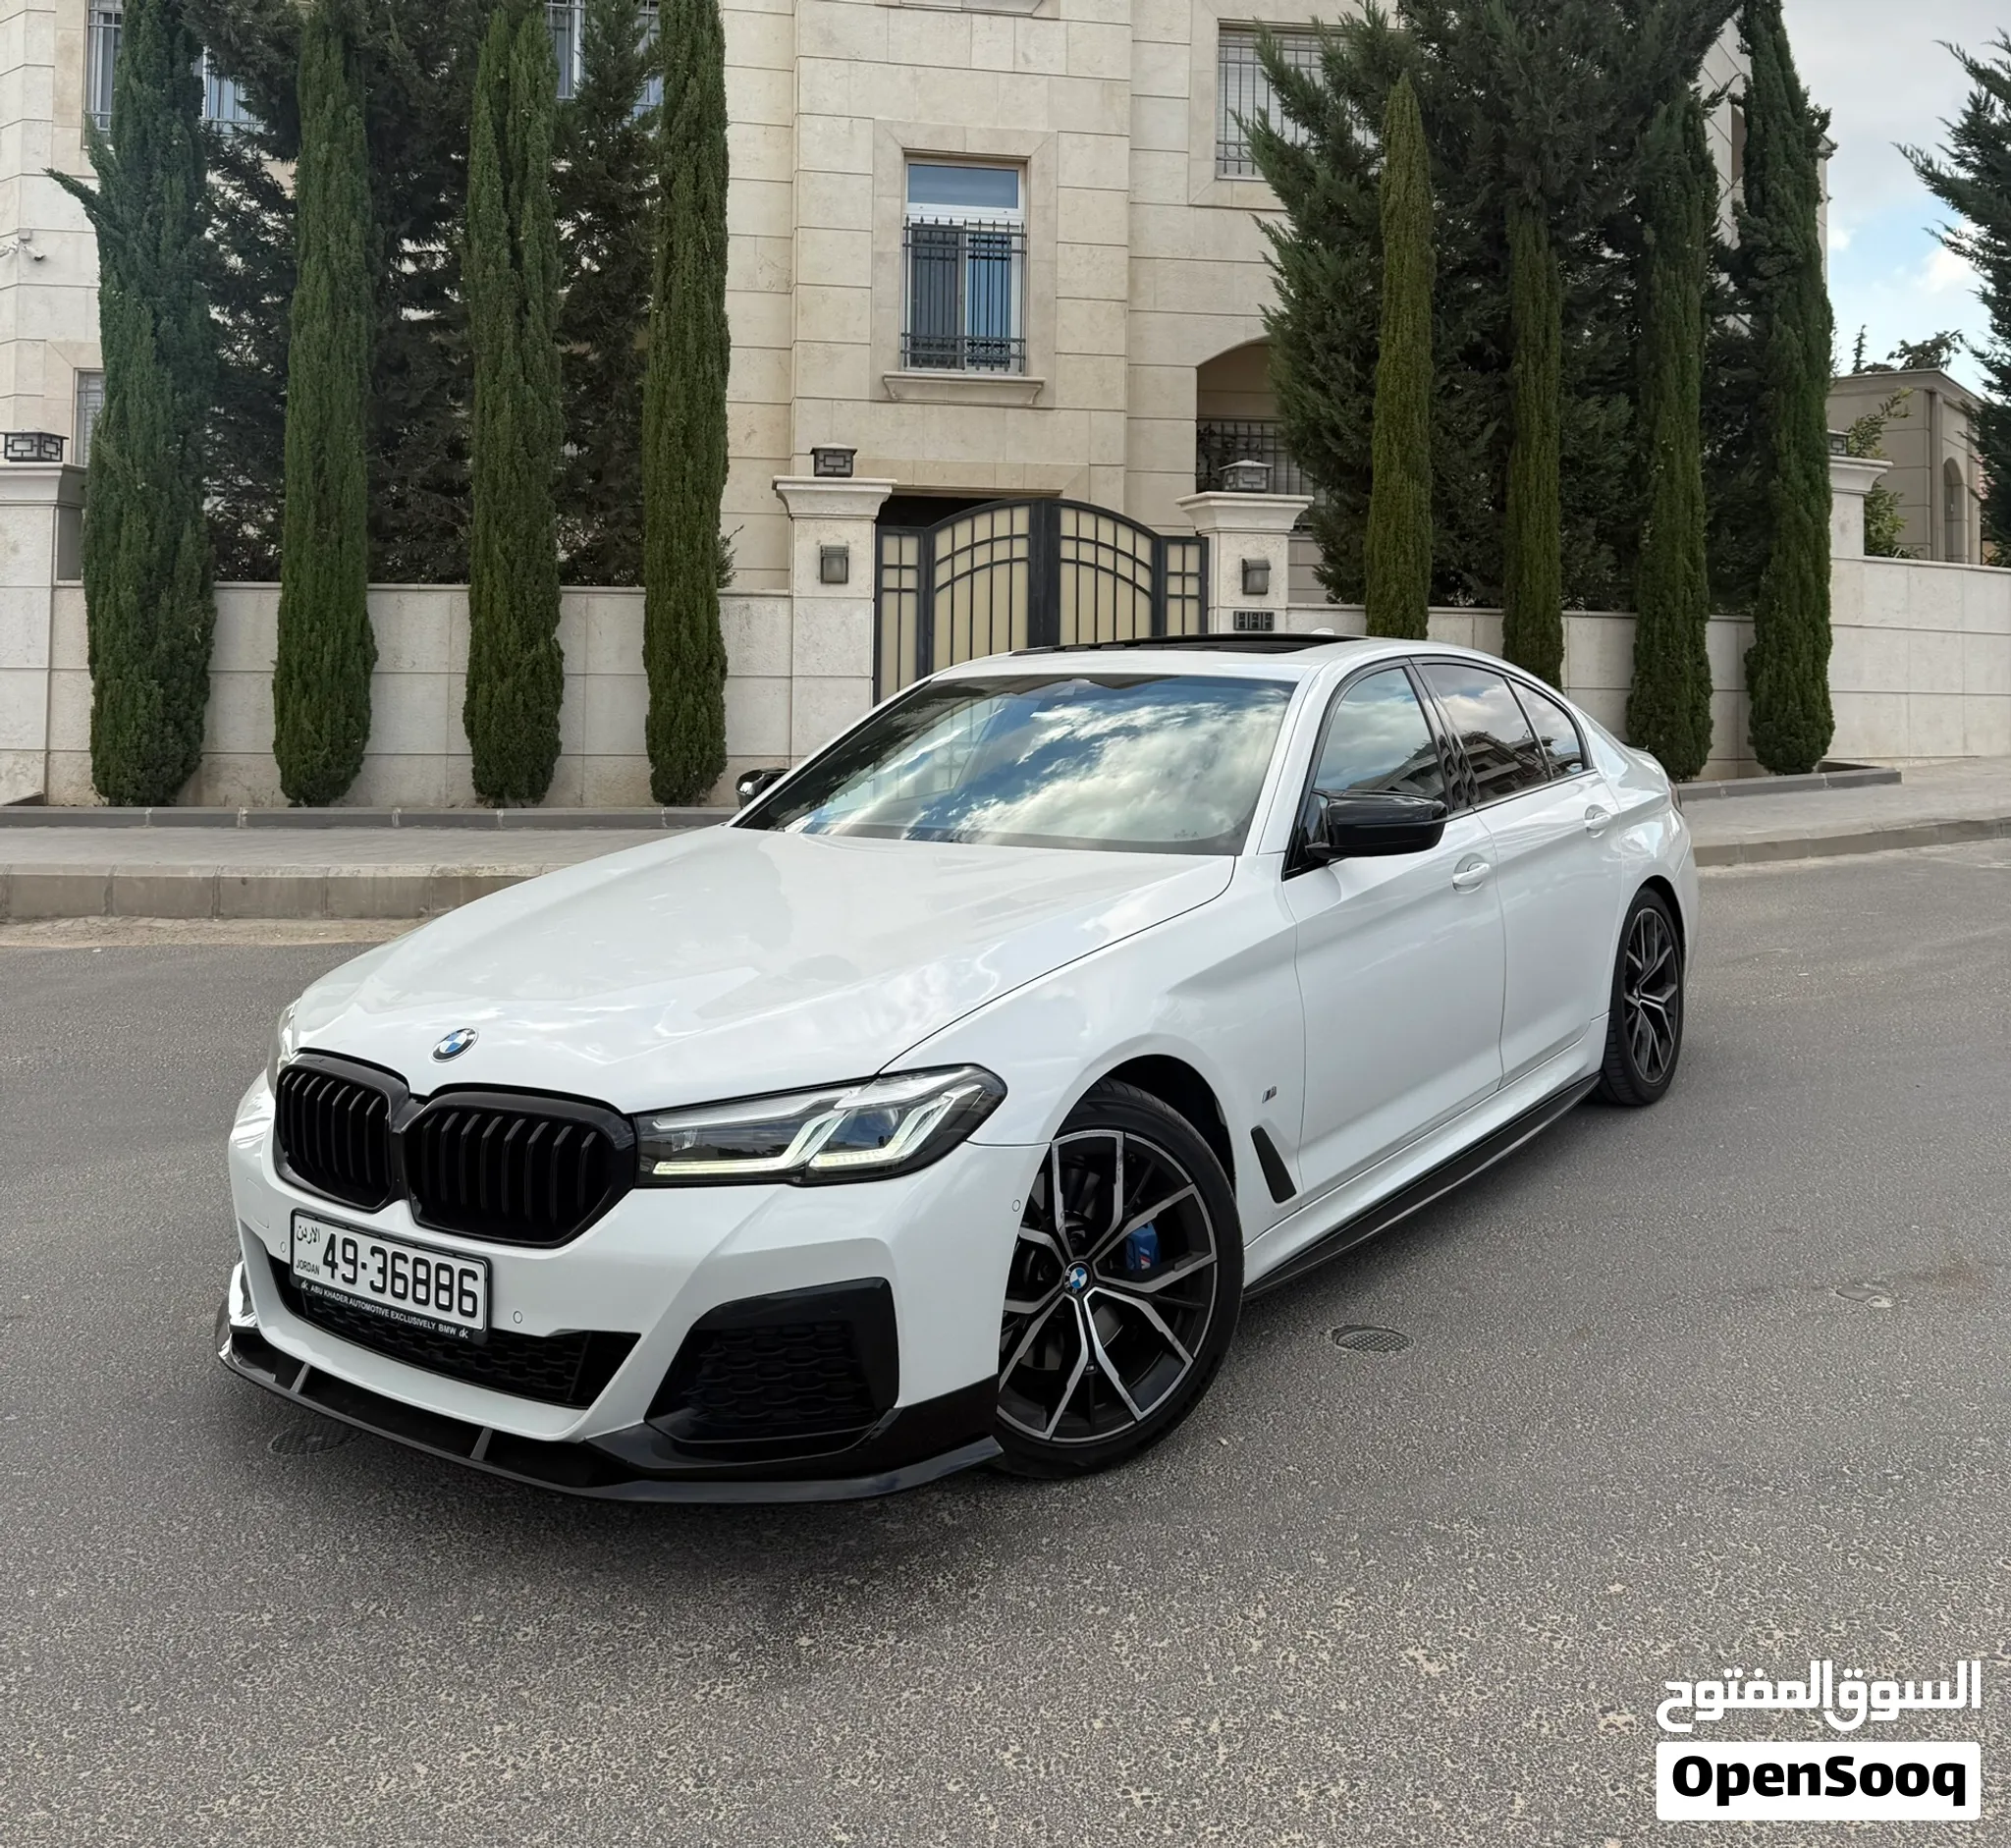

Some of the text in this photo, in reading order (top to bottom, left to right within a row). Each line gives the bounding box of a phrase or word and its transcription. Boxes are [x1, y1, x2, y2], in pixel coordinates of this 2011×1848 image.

[296, 1259, 320, 1275] JORDAN
[322, 1232, 478, 1319] 49-36886
[310, 1285, 323, 1295] ABU
[323, 1289, 349, 1305] KHADER
[349, 1297, 390, 1317] AUTOMOTIVE
[390, 1310, 436, 1330] EXCLUSIVELY
[438, 1324, 457, 1335] BMW
